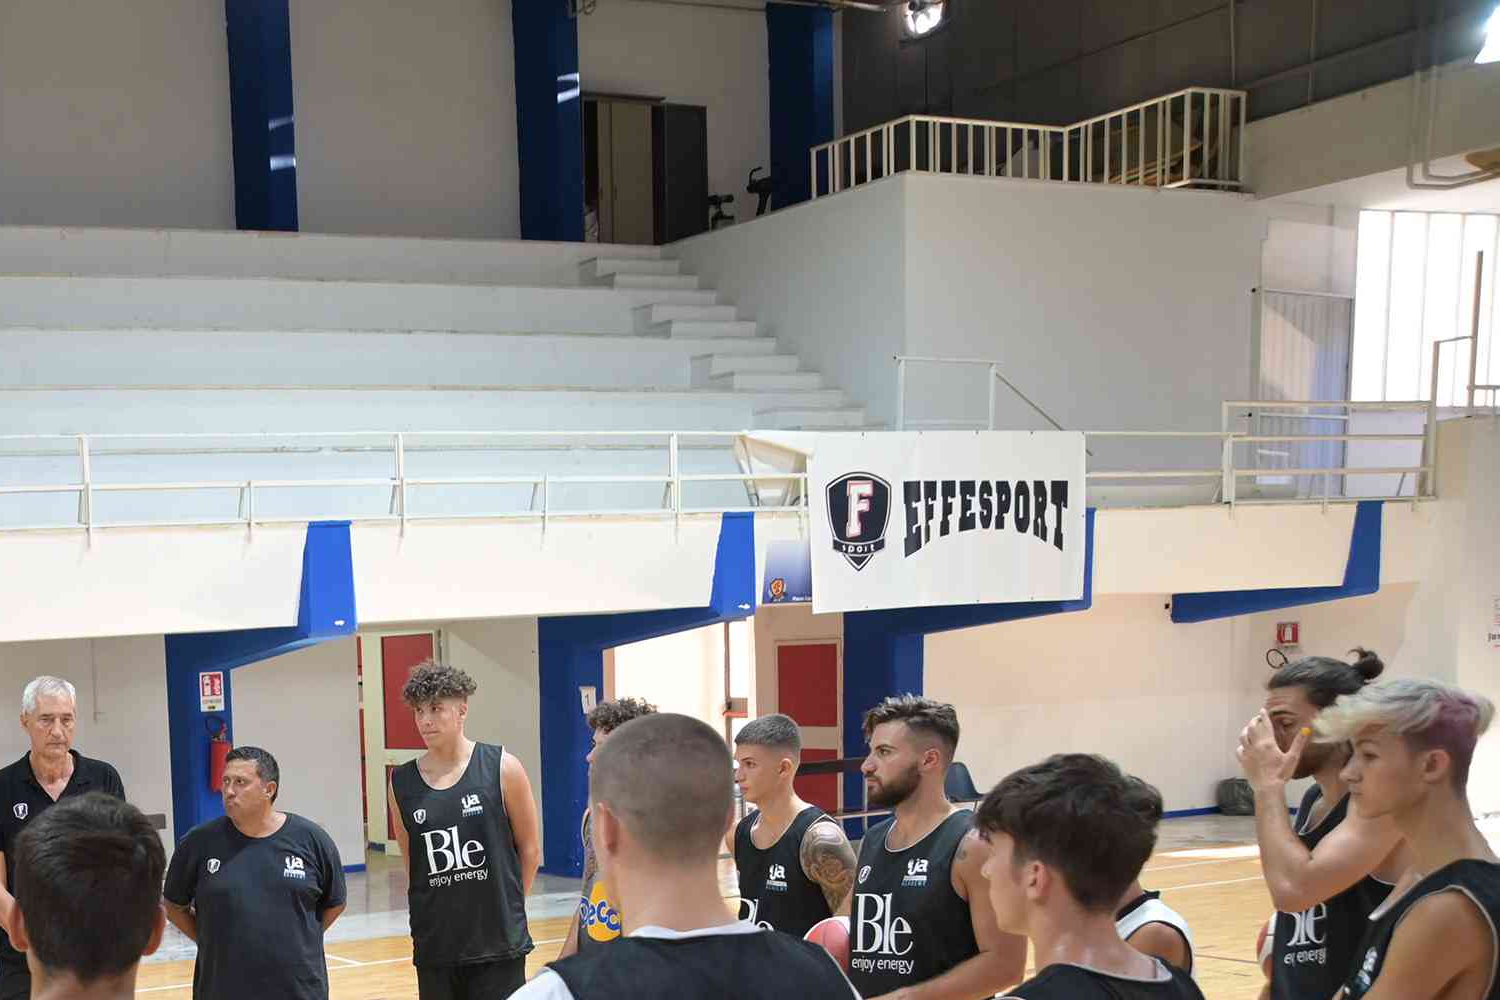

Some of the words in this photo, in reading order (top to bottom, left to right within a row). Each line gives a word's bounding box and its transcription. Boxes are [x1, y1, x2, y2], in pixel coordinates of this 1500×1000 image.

[903, 480, 1069, 558] EFFESPORT
[420, 825, 486, 876] Ble
[429, 875, 452, 888] enjoy
[454, 867, 488, 881] energy
[852, 892, 914, 955] Ble
[852, 957, 875, 973] enjoy
[877, 959, 914, 974] energy
